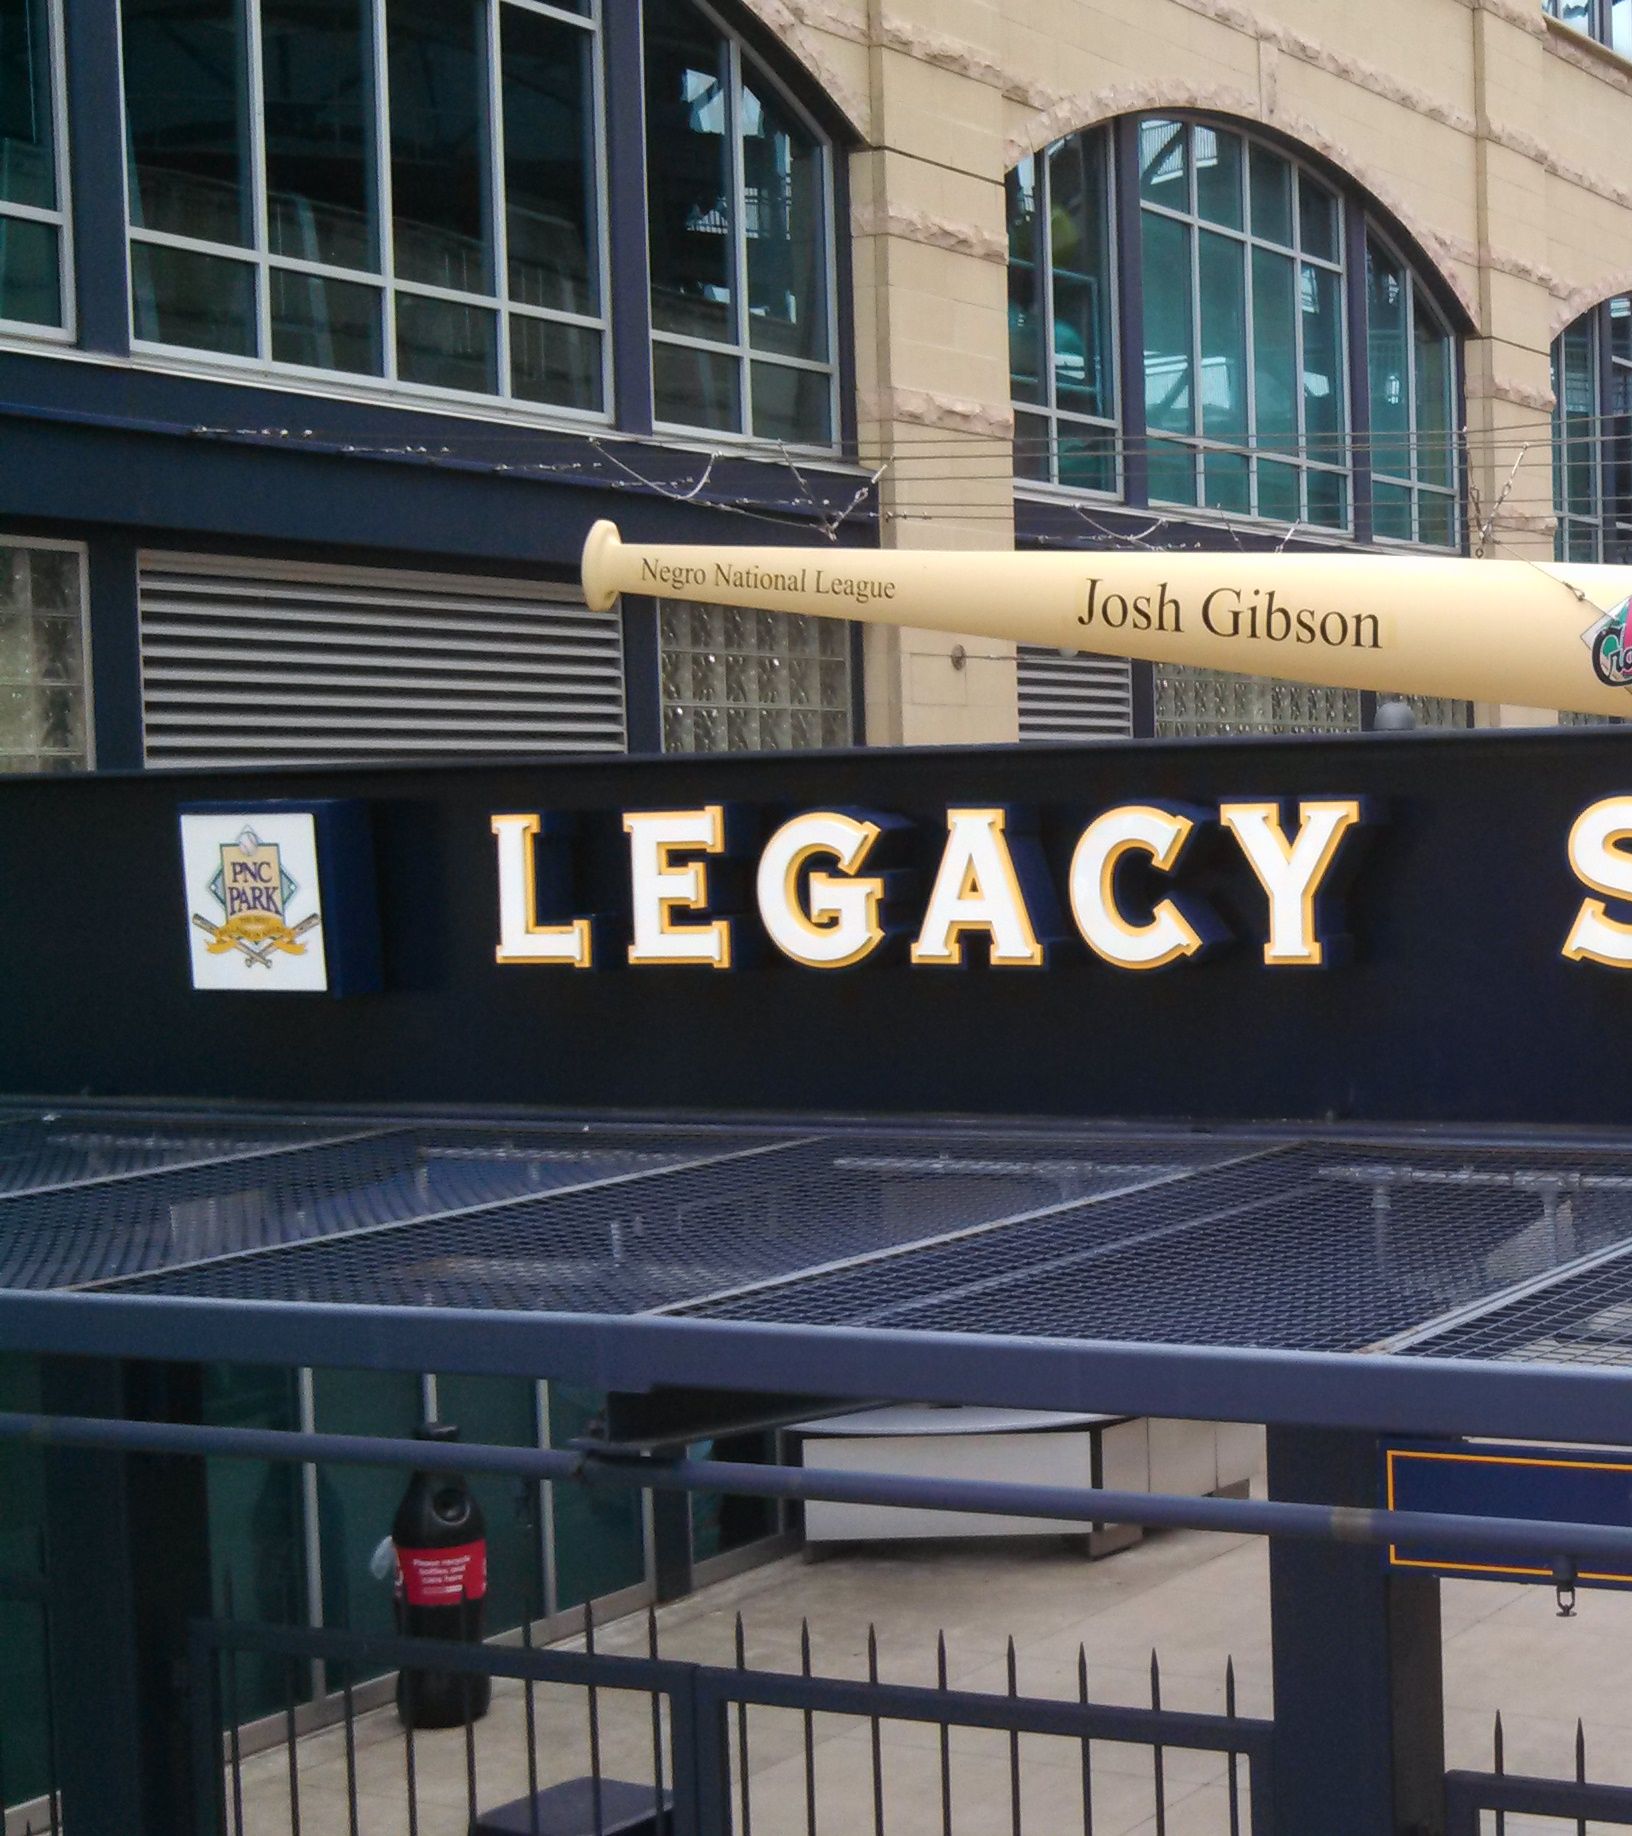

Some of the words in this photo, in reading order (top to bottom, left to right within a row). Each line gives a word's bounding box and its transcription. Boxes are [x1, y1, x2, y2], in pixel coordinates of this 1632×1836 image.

[641, 558, 707, 590] Negro
[714, 562, 807, 593] National
[815, 570, 896, 604] League
[1077, 578, 1185, 633] Josh
[1201, 588, 1383, 649] Gibson
[230, 861, 273, 883] PNC
[490, 800, 1360, 969] LEGACY
[228, 886, 281, 916] PARK
